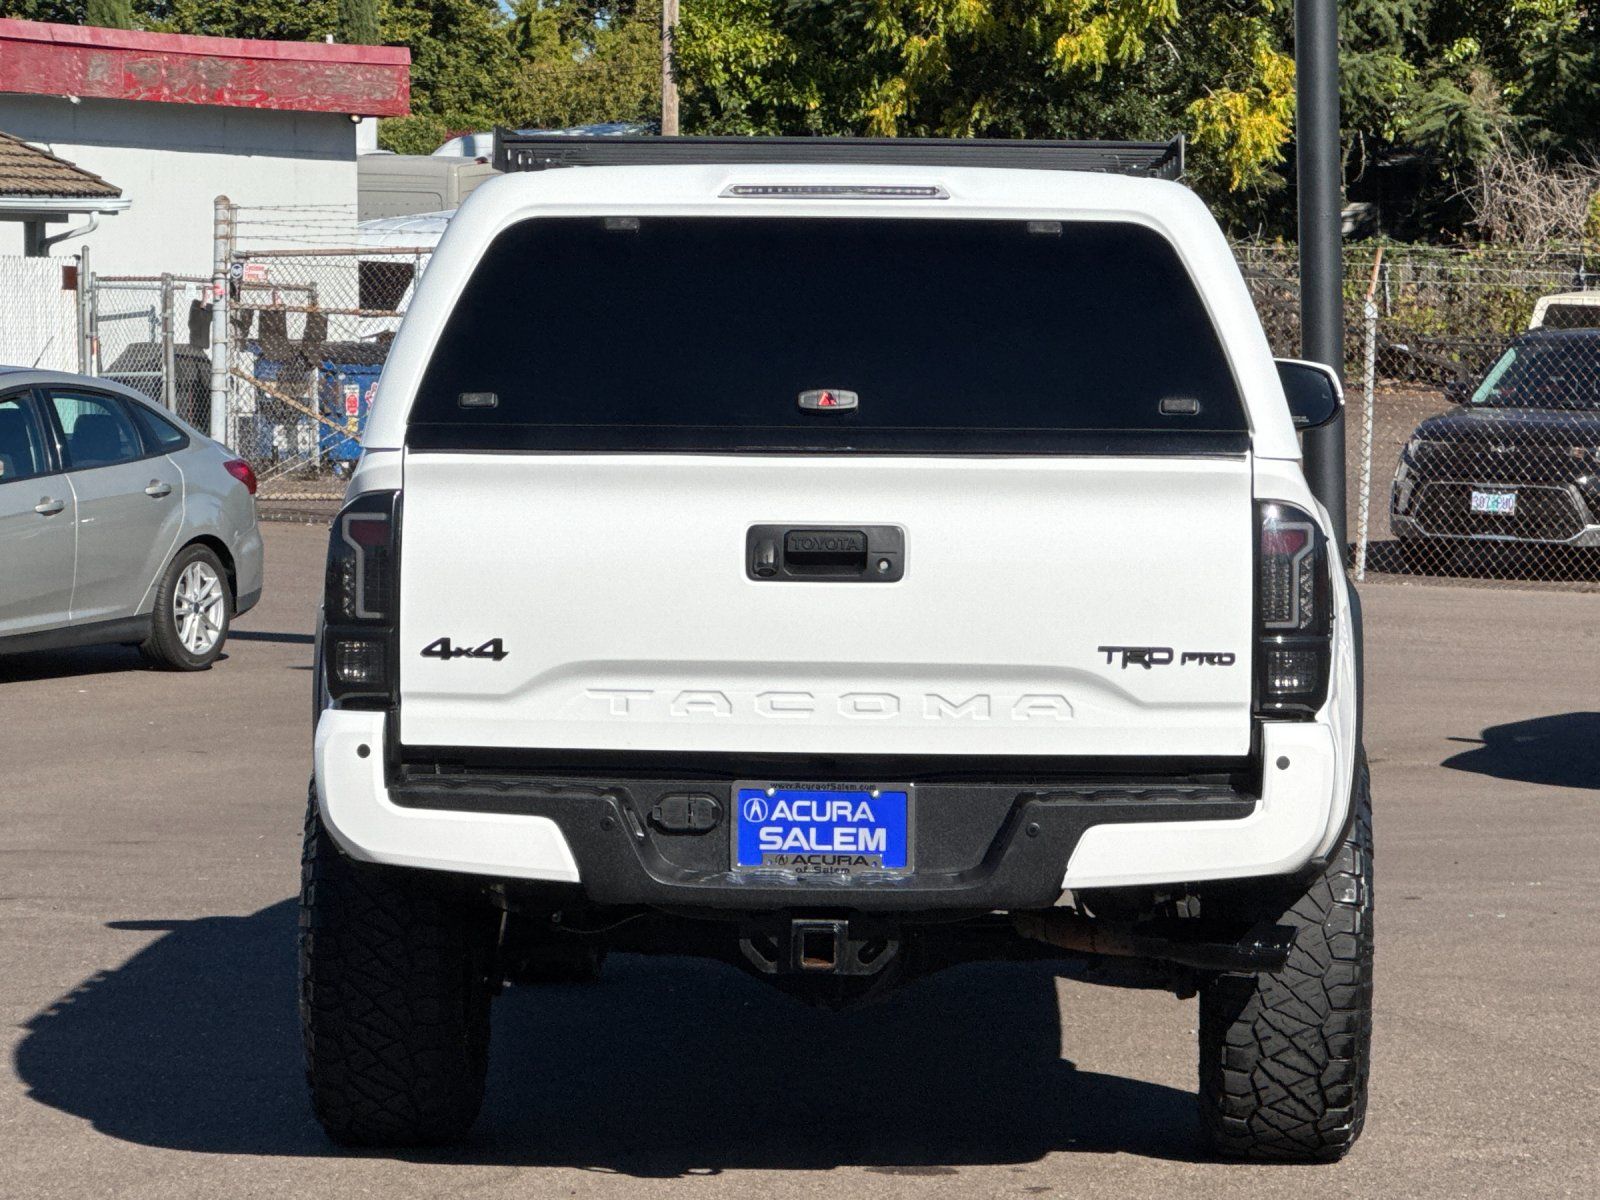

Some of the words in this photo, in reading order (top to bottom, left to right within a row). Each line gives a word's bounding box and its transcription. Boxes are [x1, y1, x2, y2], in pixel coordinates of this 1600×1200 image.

[790, 536, 861, 552] TOYOTA
[420, 637, 510, 662] 4x4
[1097, 646, 1174, 670] TRD
[1180, 652, 1236, 667] PRO
[586, 688, 1075, 721] TACOMA
[770, 800, 875, 822] ACURA
[758, 826, 887, 851] SALEM
[790, 854, 869, 866] ACURA
[813, 866, 850, 875] Salem
